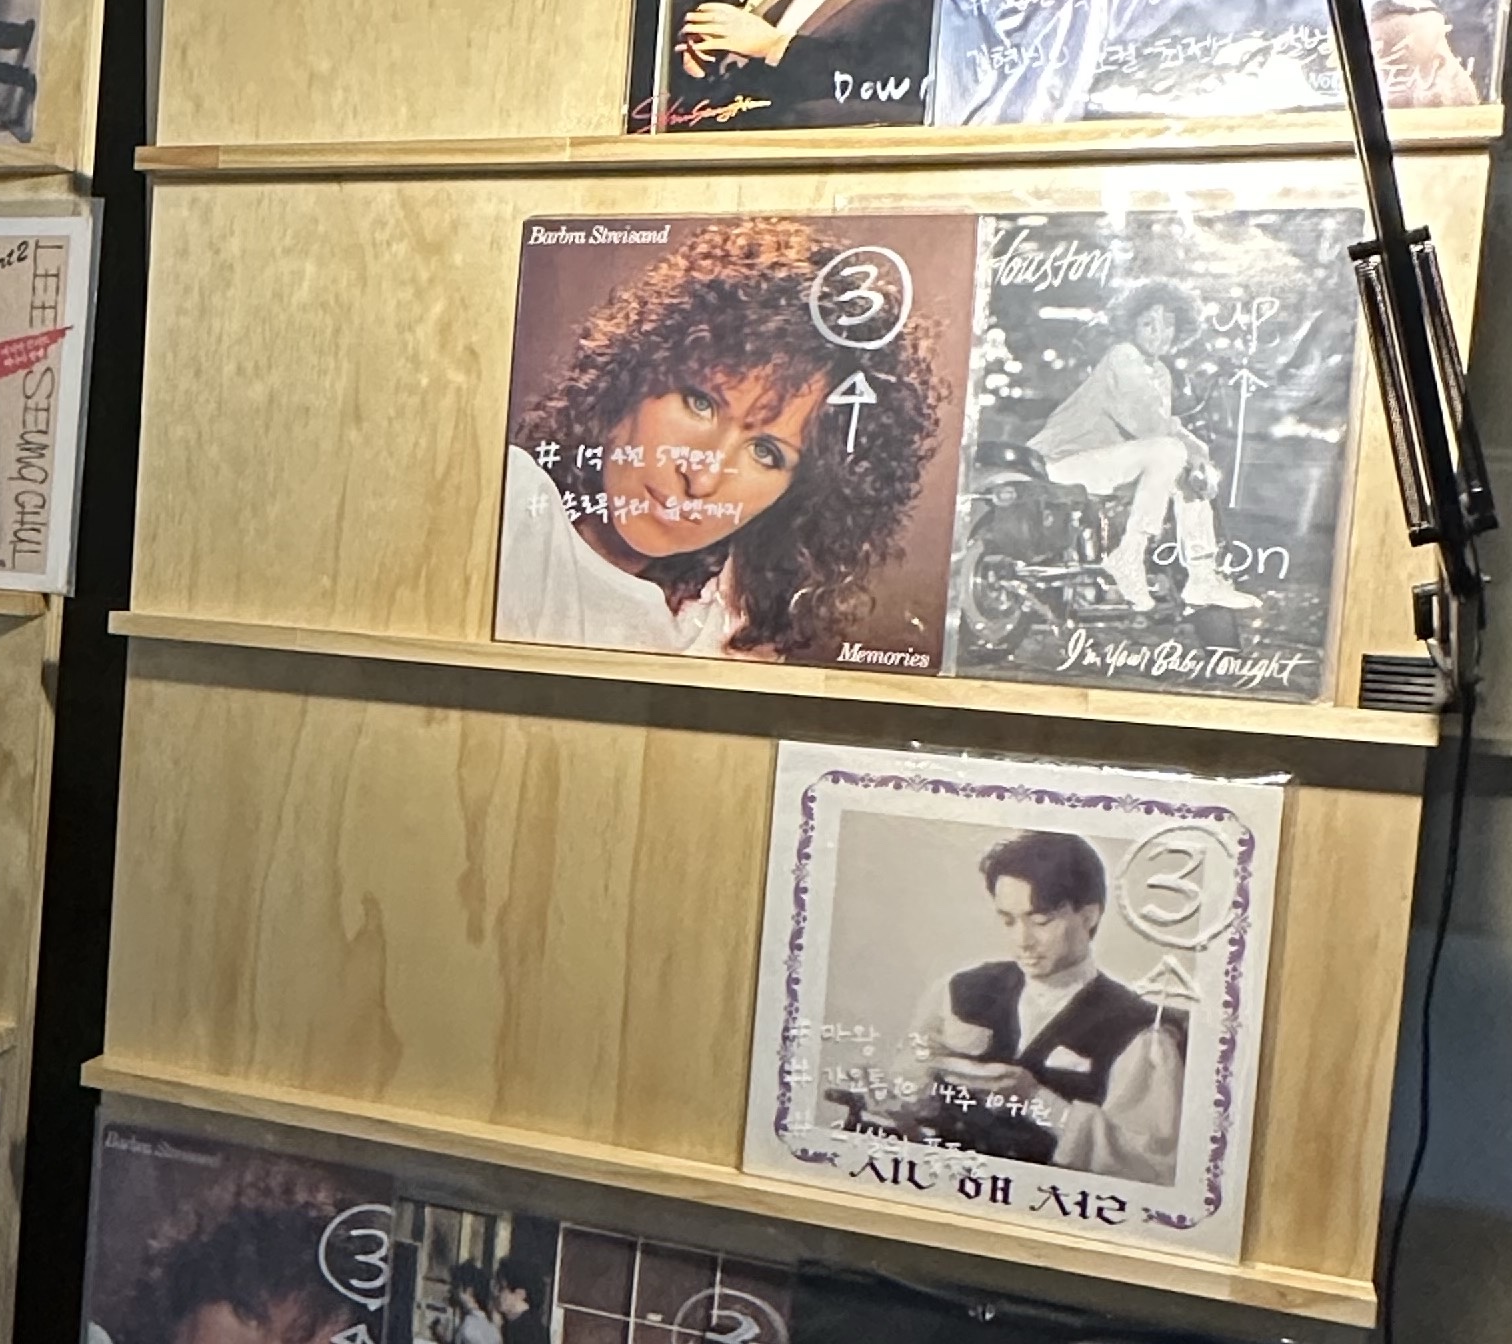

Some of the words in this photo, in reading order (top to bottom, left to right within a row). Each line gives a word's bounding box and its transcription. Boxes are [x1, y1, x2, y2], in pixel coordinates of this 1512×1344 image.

[528, 225, 586, 245] Barbra
[589, 224, 671, 245] Streisand
[29, 239, 64, 328] LEE
[837, 642, 930, 669] Memories
[1205, 644, 1316, 690] Tonight
